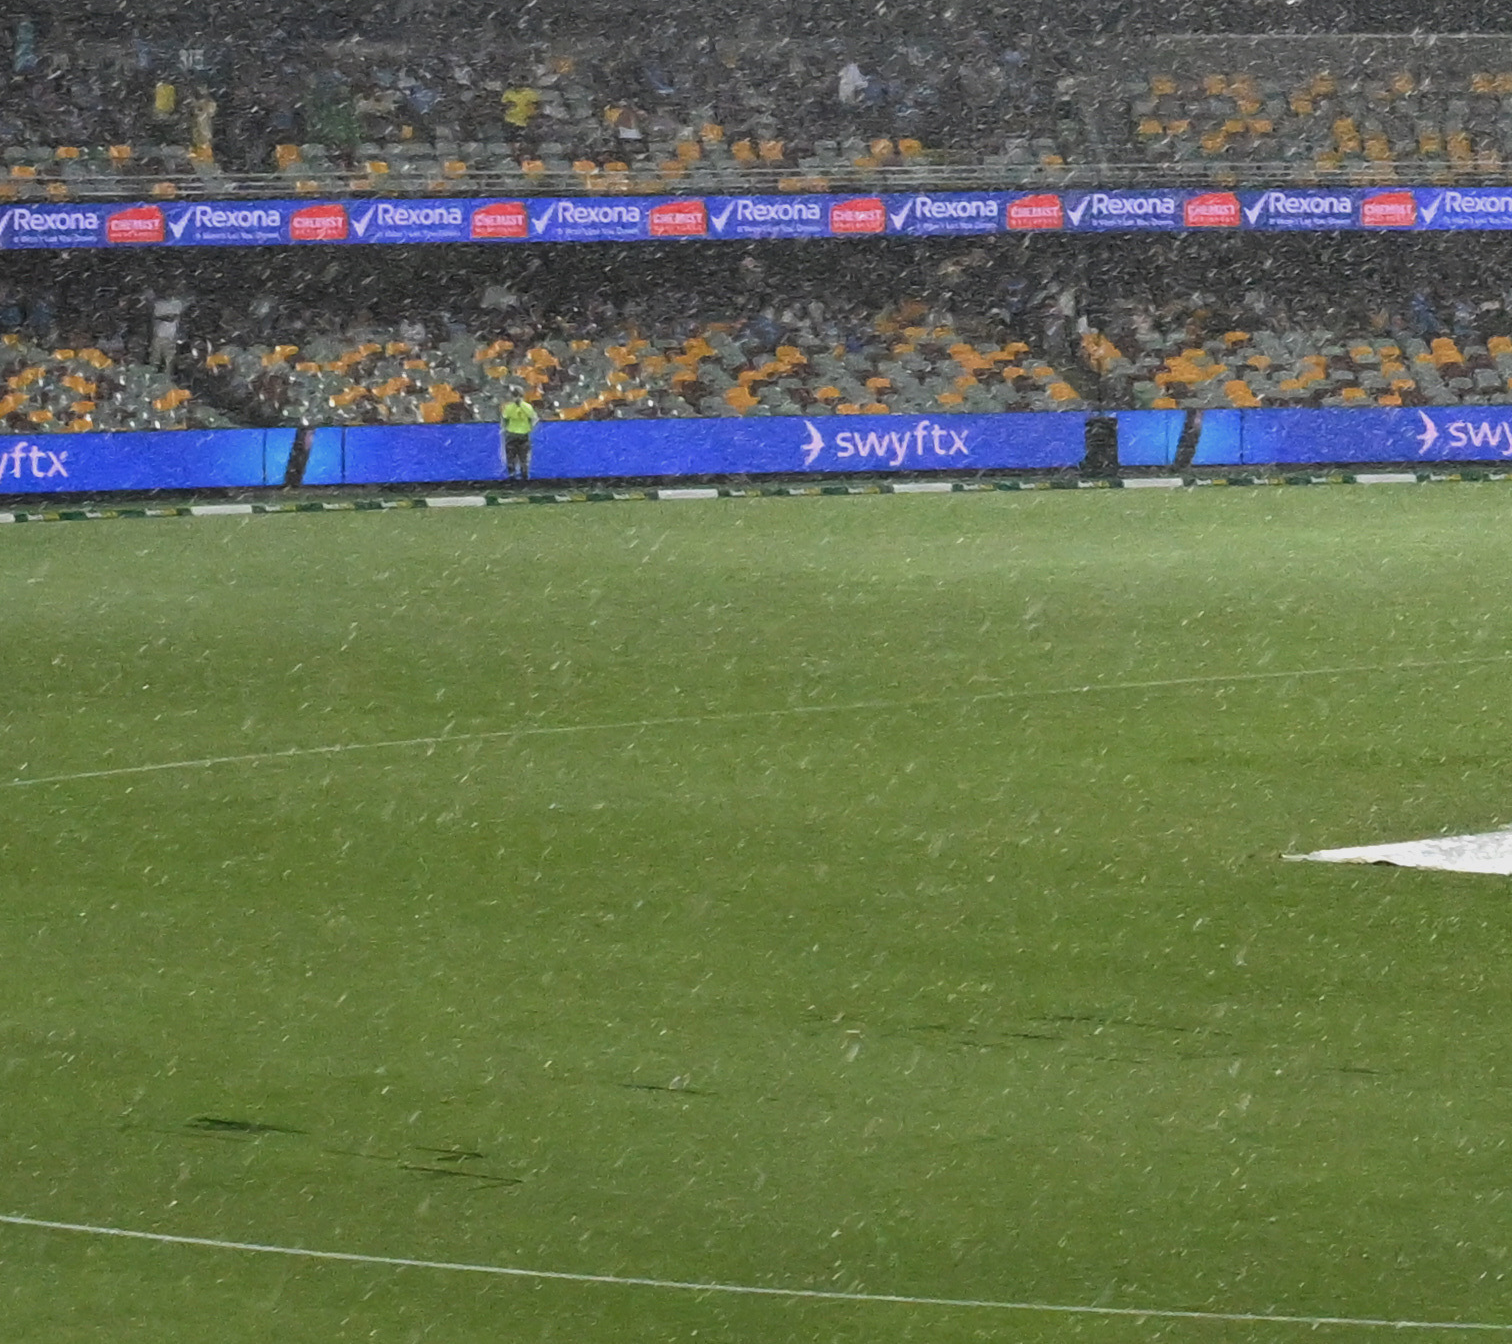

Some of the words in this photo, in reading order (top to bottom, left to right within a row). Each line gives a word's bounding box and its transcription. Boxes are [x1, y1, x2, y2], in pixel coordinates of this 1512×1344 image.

[558, 202, 640, 223] Rexona
[738, 200, 820, 220] Rexona
[916, 197, 997, 217] Rexona
[1092, 194, 1174, 214] Rexona
[1269, 192, 1351, 213] Rexona
[14, 209, 99, 230] Rexona
[196, 206, 280, 227] Rexona
[378, 204, 461, 225] Rexona
[836, 421, 968, 465] swyftx
